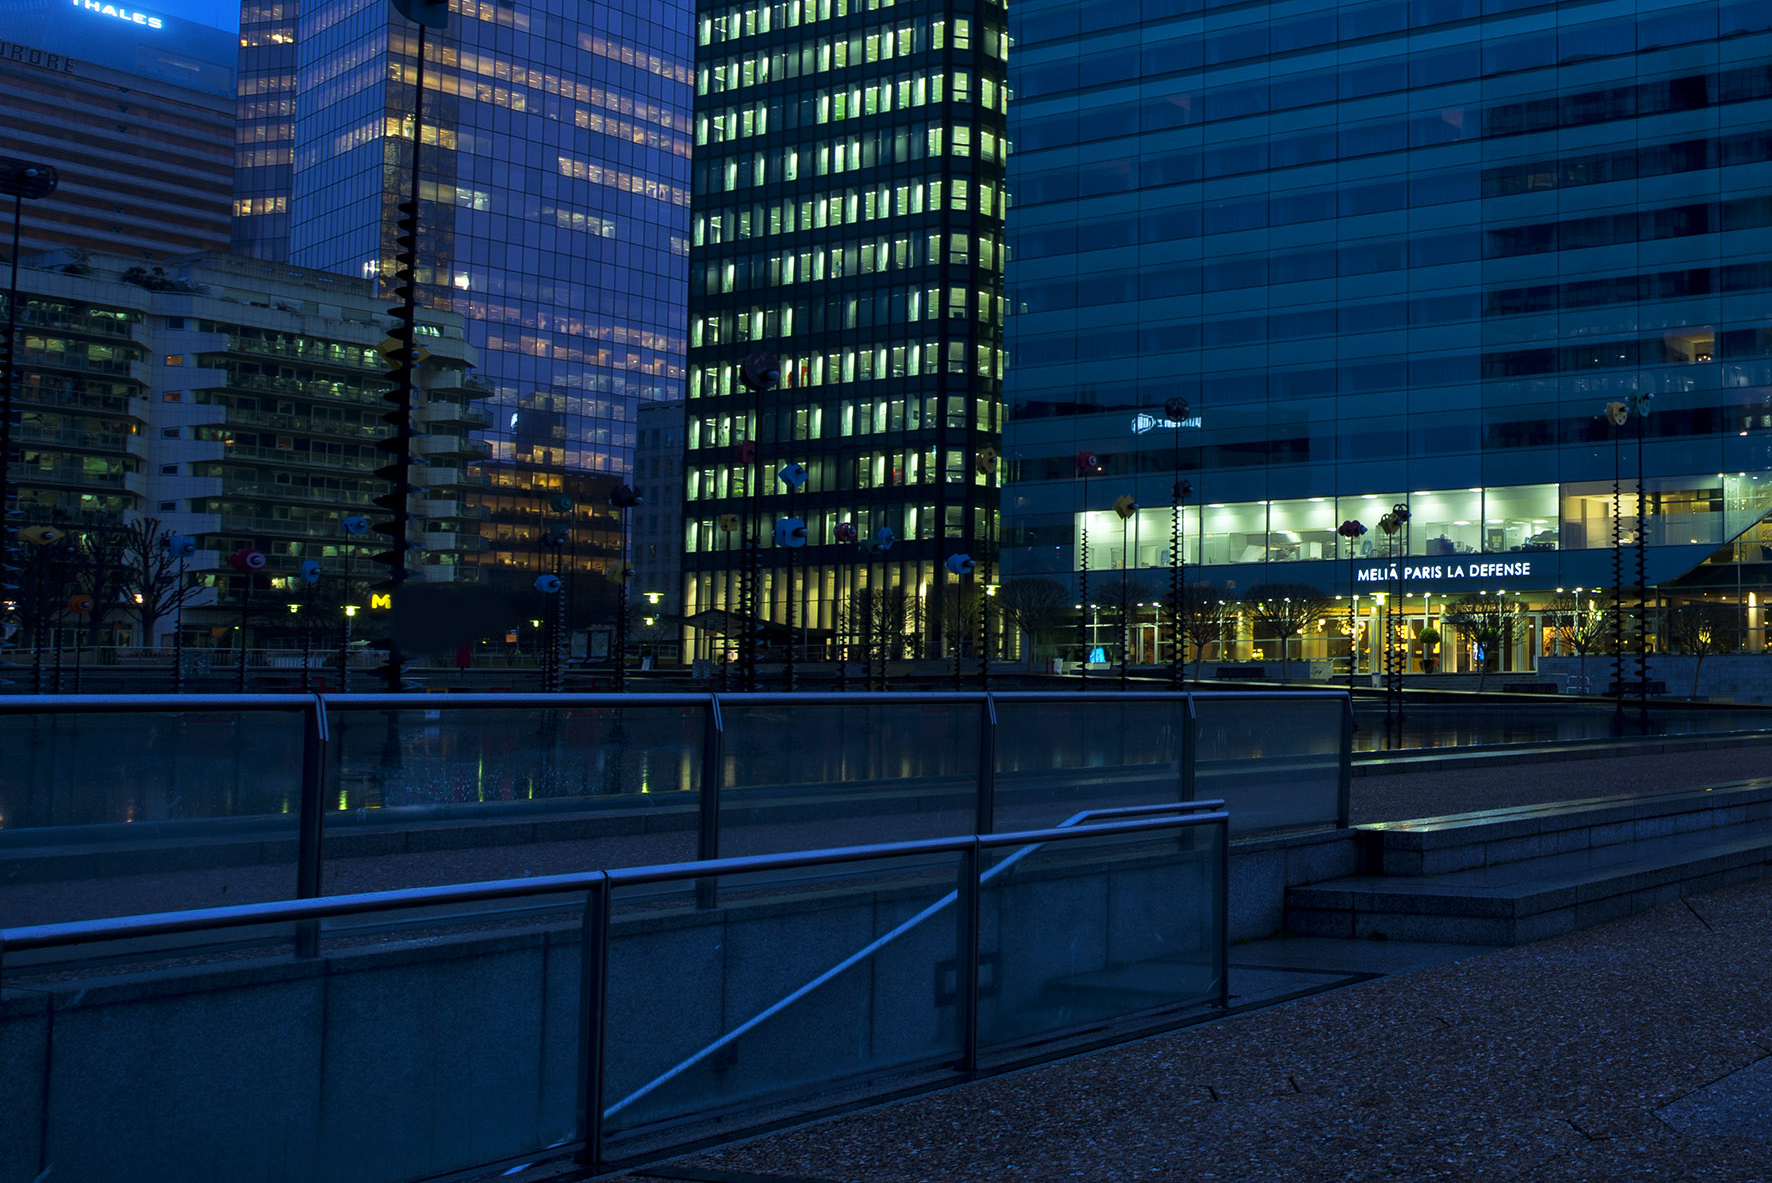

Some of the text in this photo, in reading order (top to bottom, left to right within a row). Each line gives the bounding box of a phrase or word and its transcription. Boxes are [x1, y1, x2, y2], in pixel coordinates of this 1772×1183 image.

[1404, 565, 1442, 580] PARIS
[1447, 565, 1465, 578] LA
[1469, 562, 1531, 578] DEFENSE
